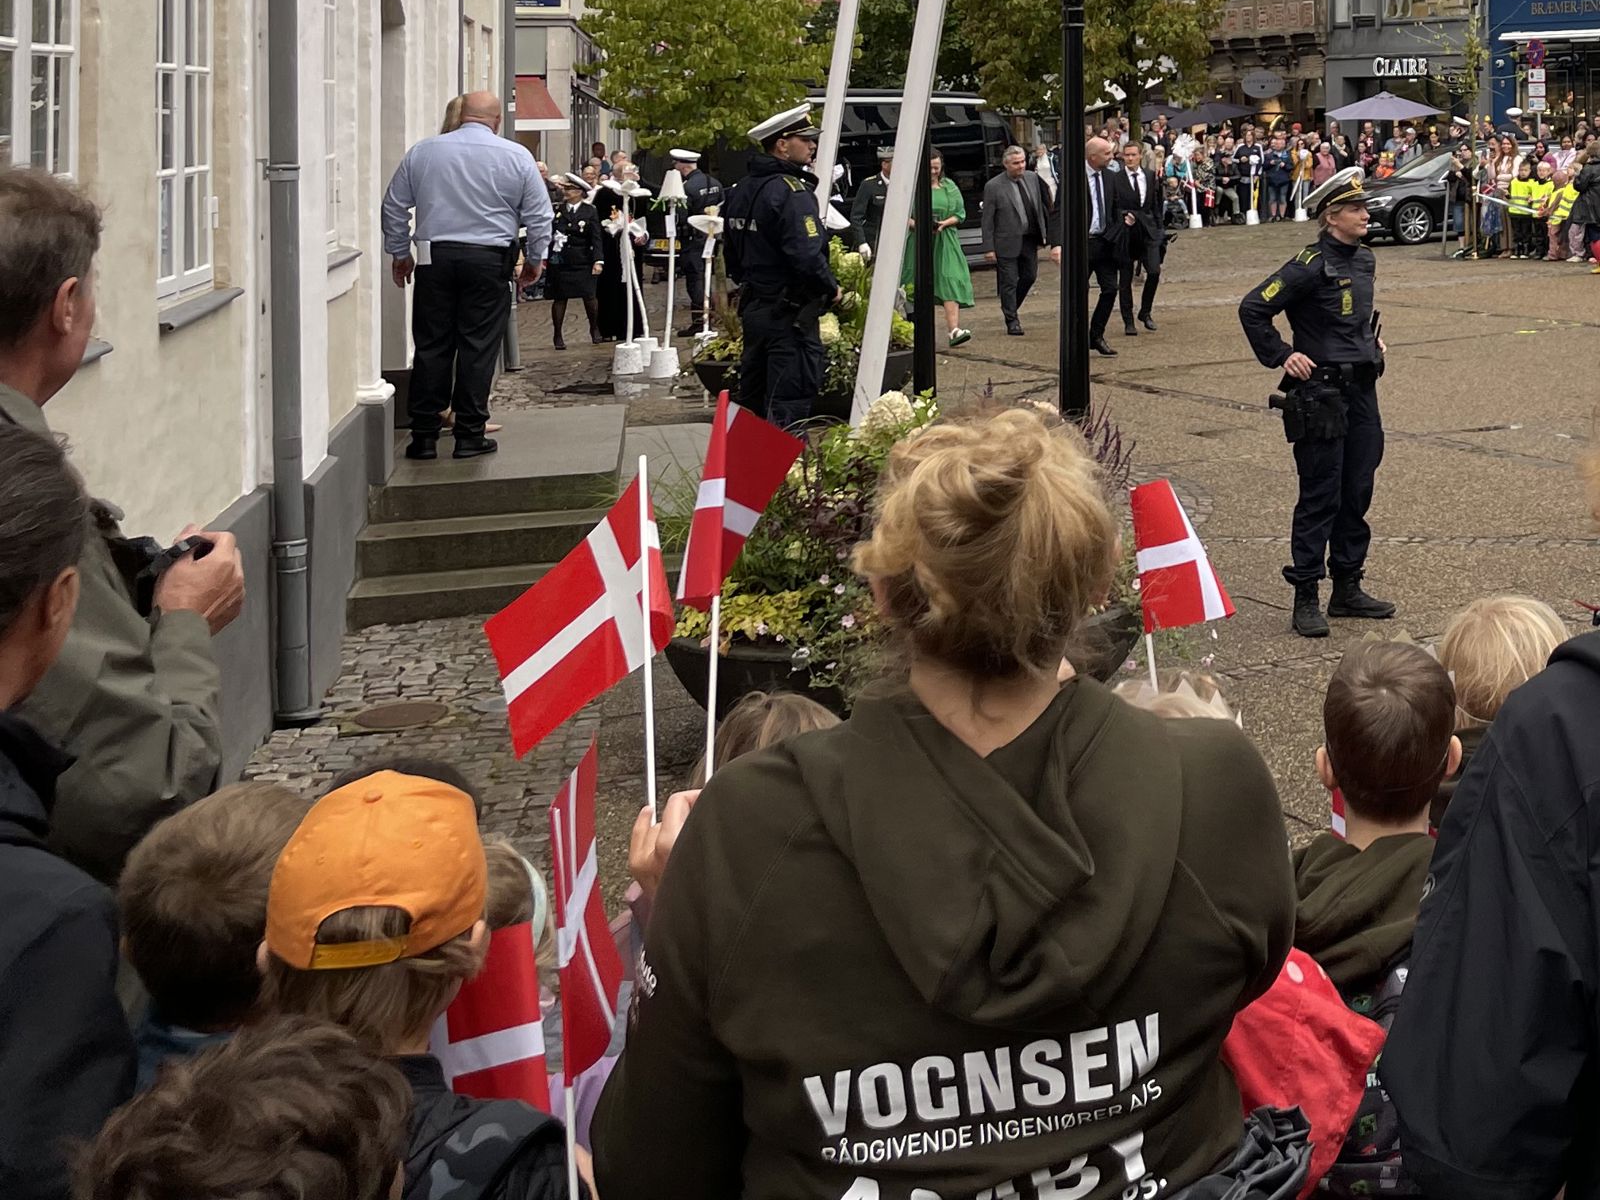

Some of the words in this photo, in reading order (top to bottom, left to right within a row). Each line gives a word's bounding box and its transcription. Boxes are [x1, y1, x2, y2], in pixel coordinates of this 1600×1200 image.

[1373, 57, 1428, 76] CLAIRE
[803, 1012, 1160, 1137] VOGNSEN
[821, 1125, 974, 1165] RÅDGIVENDE
[980, 1103, 1123, 1146] INGENIØRER
[1130, 1079, 1163, 1113] A/S
